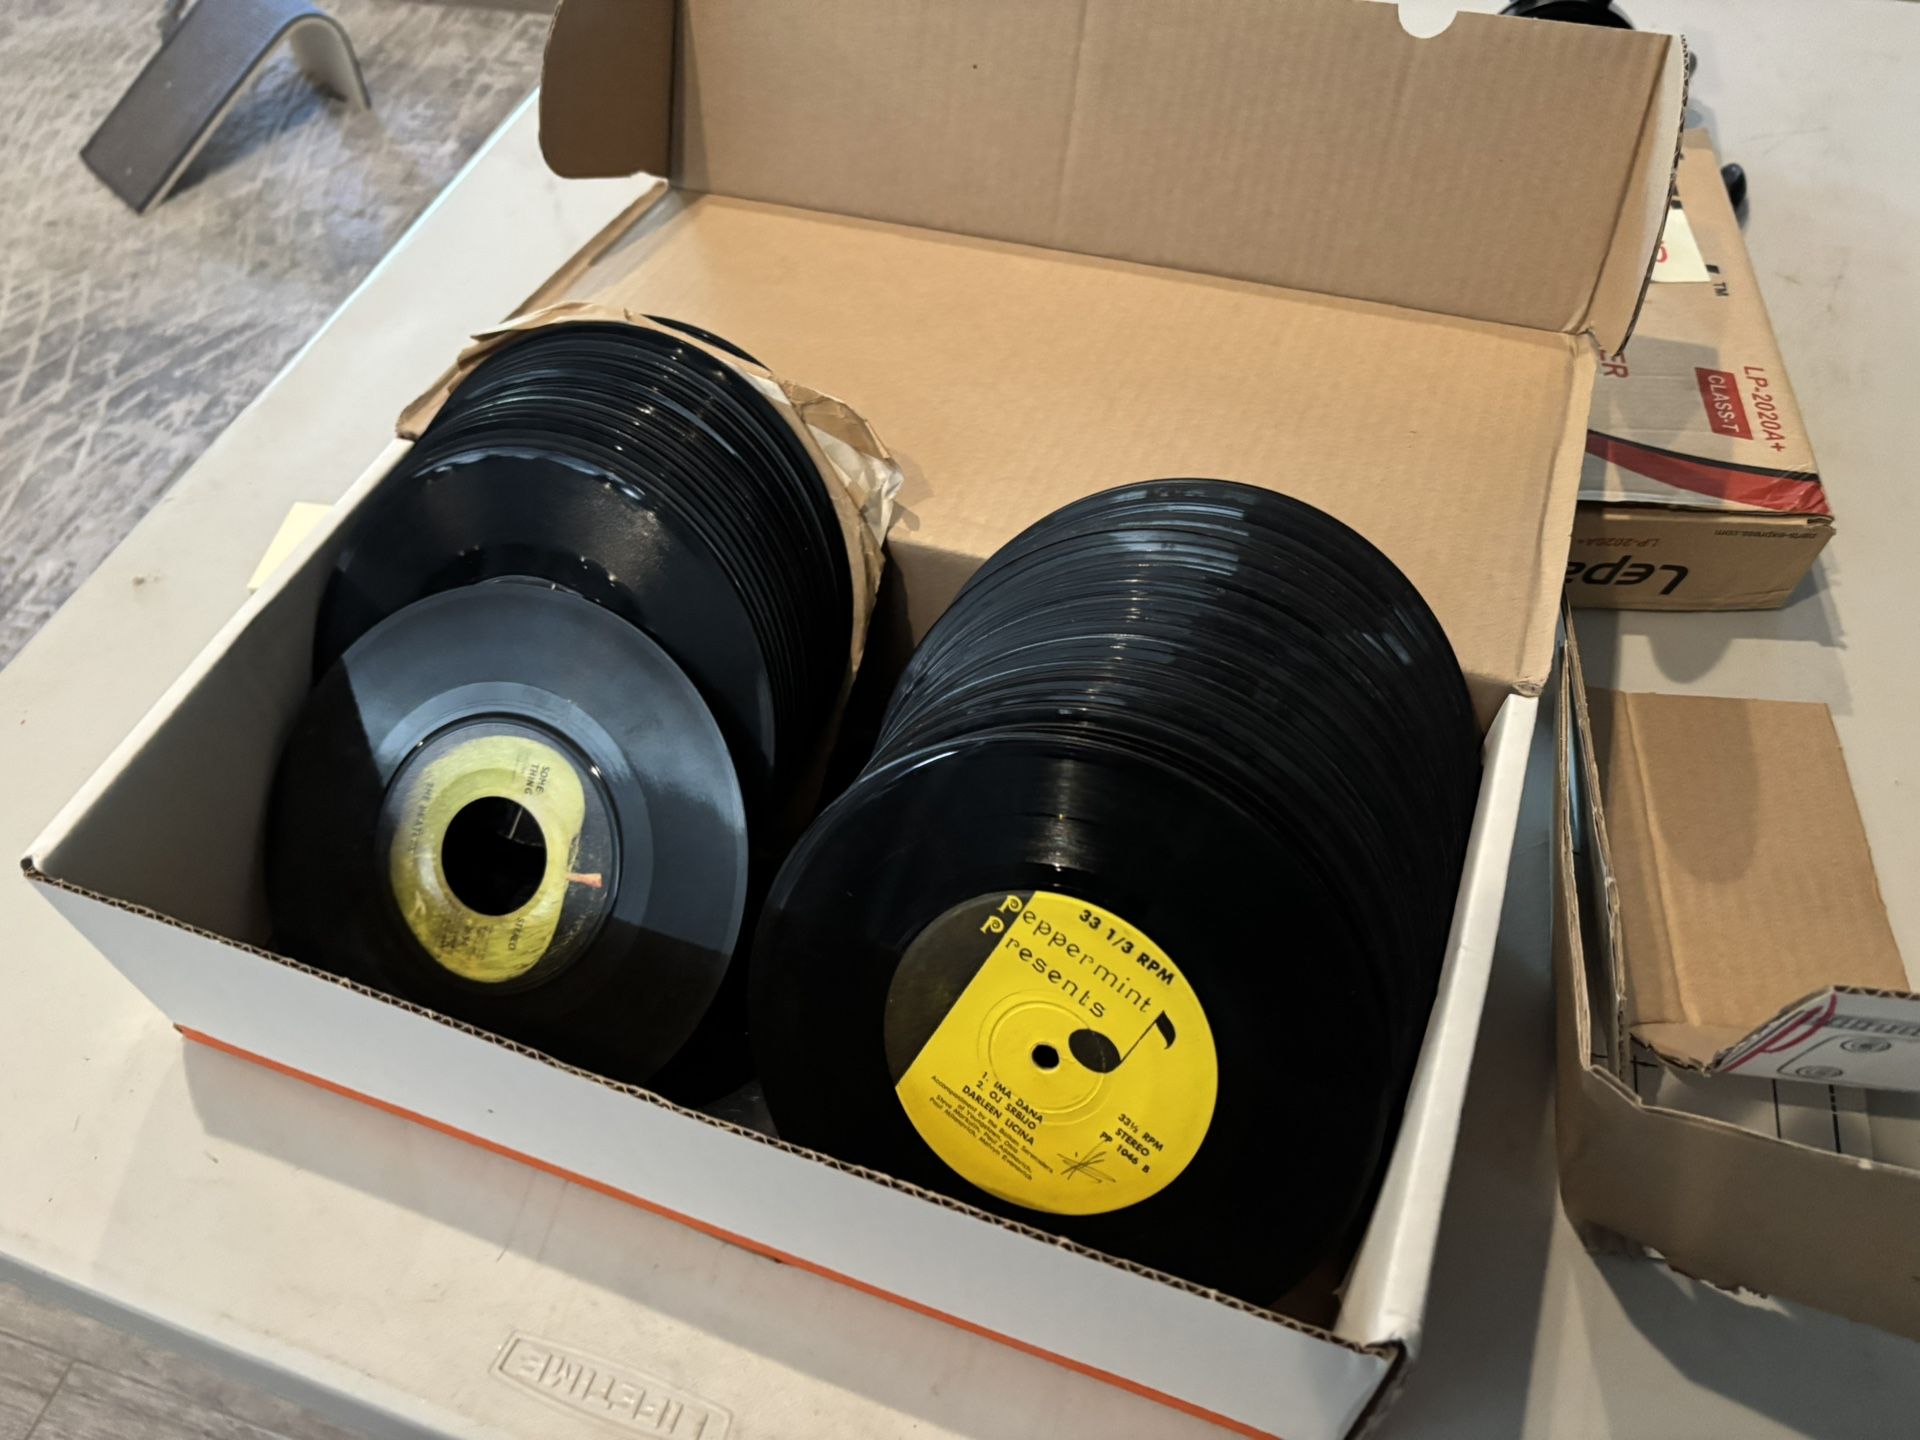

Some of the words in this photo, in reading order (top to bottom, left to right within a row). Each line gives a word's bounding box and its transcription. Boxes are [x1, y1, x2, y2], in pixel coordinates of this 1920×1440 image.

[1712, 281, 1729, 297] TM
[1743, 365, 1786, 452] LP-2020A+
[1714, 528, 1818, 539] parts-express.com
[524, 764, 539, 795] THING
[1078, 909, 1102, 931] 33
[1105, 928, 1135, 954] 1/3
[1136, 952, 1175, 986] RPM
[962, 1085, 1003, 1119] DARLEEN
[1004, 1118, 1035, 1146] LICINA
[989, 1090, 1002, 1104] OJ
[1005, 1103, 1037, 1130] SRBIJO
[993, 1081, 1012, 1099] IMA
[1015, 1098, 1043, 1124] DANA
[988, 1119, 998, 1129] the
[1099, 1131, 1113, 1143] PP
[1116, 1144, 1139, 1165] 1046
[1115, 1127, 1150, 1157] STEREO
[1142, 1132, 1164, 1152] RPM
[518, 1350, 710, 1440] LIFETIME
